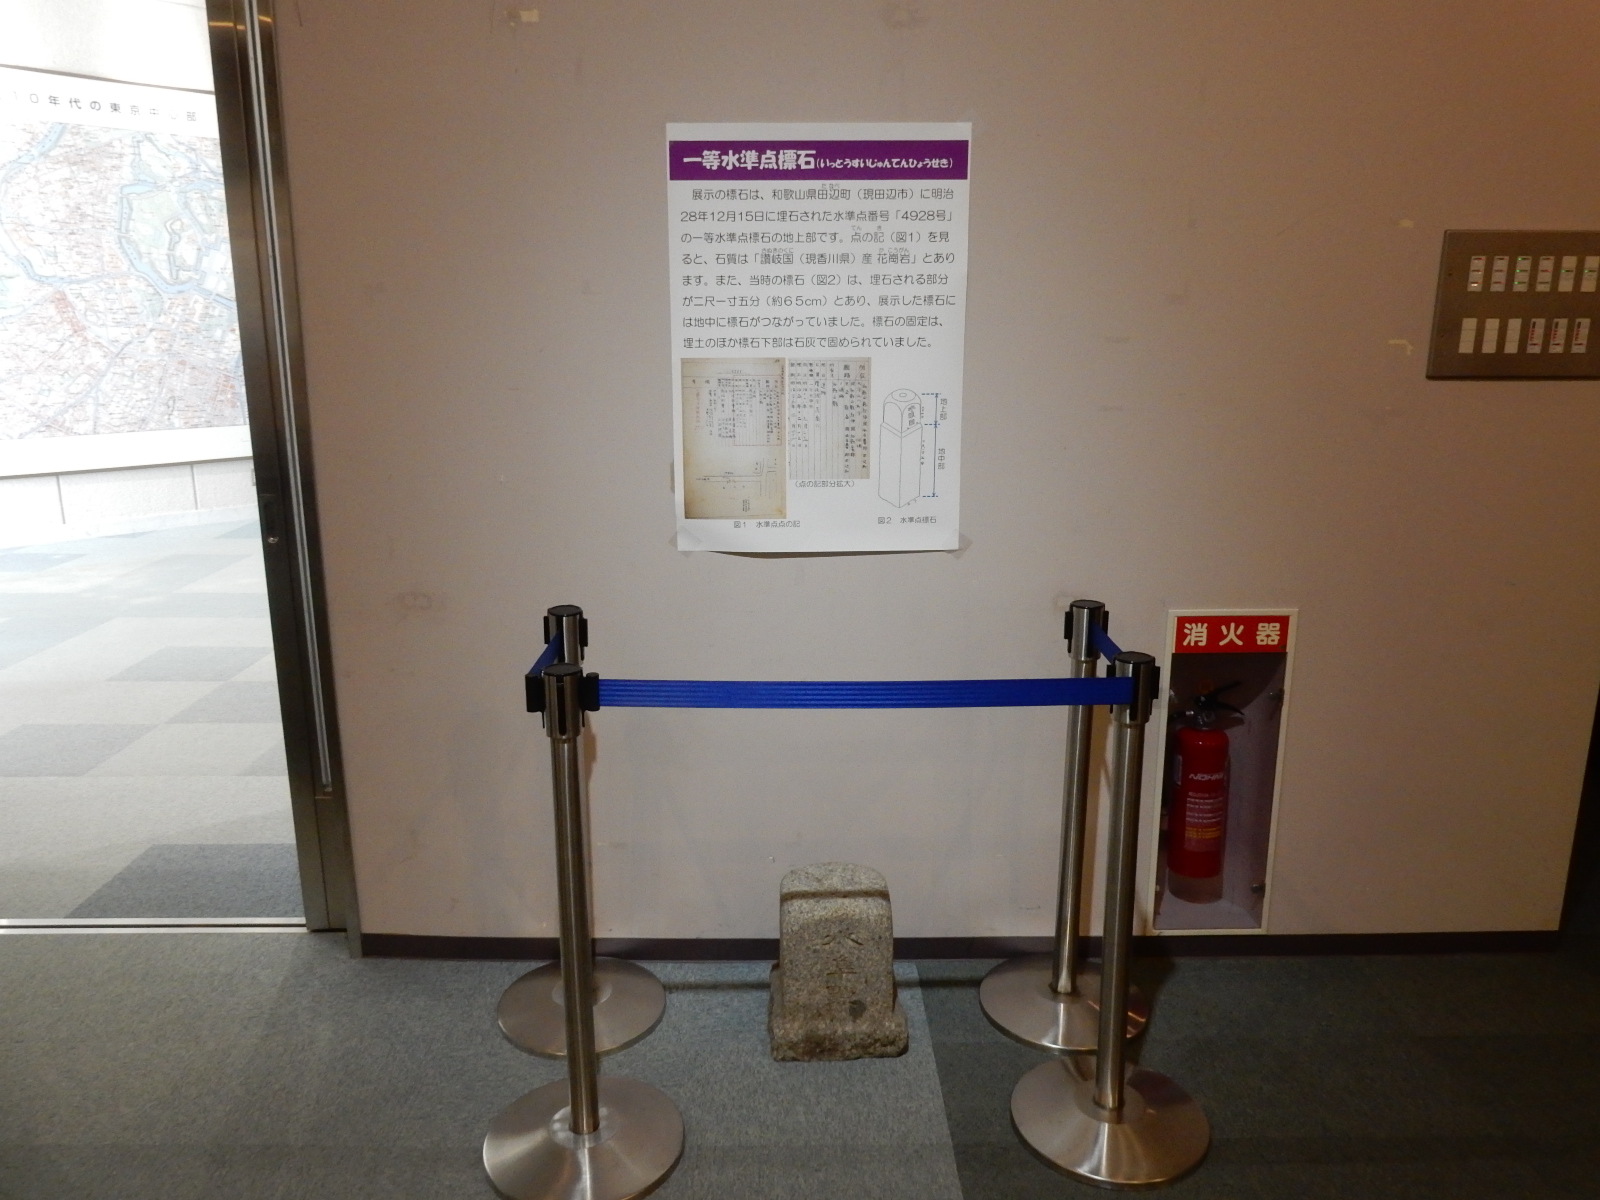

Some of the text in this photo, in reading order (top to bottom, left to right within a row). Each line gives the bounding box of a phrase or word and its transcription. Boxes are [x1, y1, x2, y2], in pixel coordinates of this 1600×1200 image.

[683, 149, 953, 171] 一等水準点標石(いっとうすいじゅんてんひょうせき)
[692, 188, 954, 201] 展示の標石は、和歌山県田辺町（現田辺市）に明治
[680, 210, 953, 222] 28年12月15日に埋石された水準点番号「4928号」
[681, 231, 950, 244] の一等水準点標石の地上部です。点の記（図1）を見
[682, 274, 949, 286] ます。また、当時の標石（図2）は、埋石される部分
[683, 316, 945, 328] は地中に標石がつながっていました。標石の固定は、
[683, 337, 933, 349] 埋土のほか標石下部は石灰で固められていました。
[1182, 622, 1281, 647] 消火器
